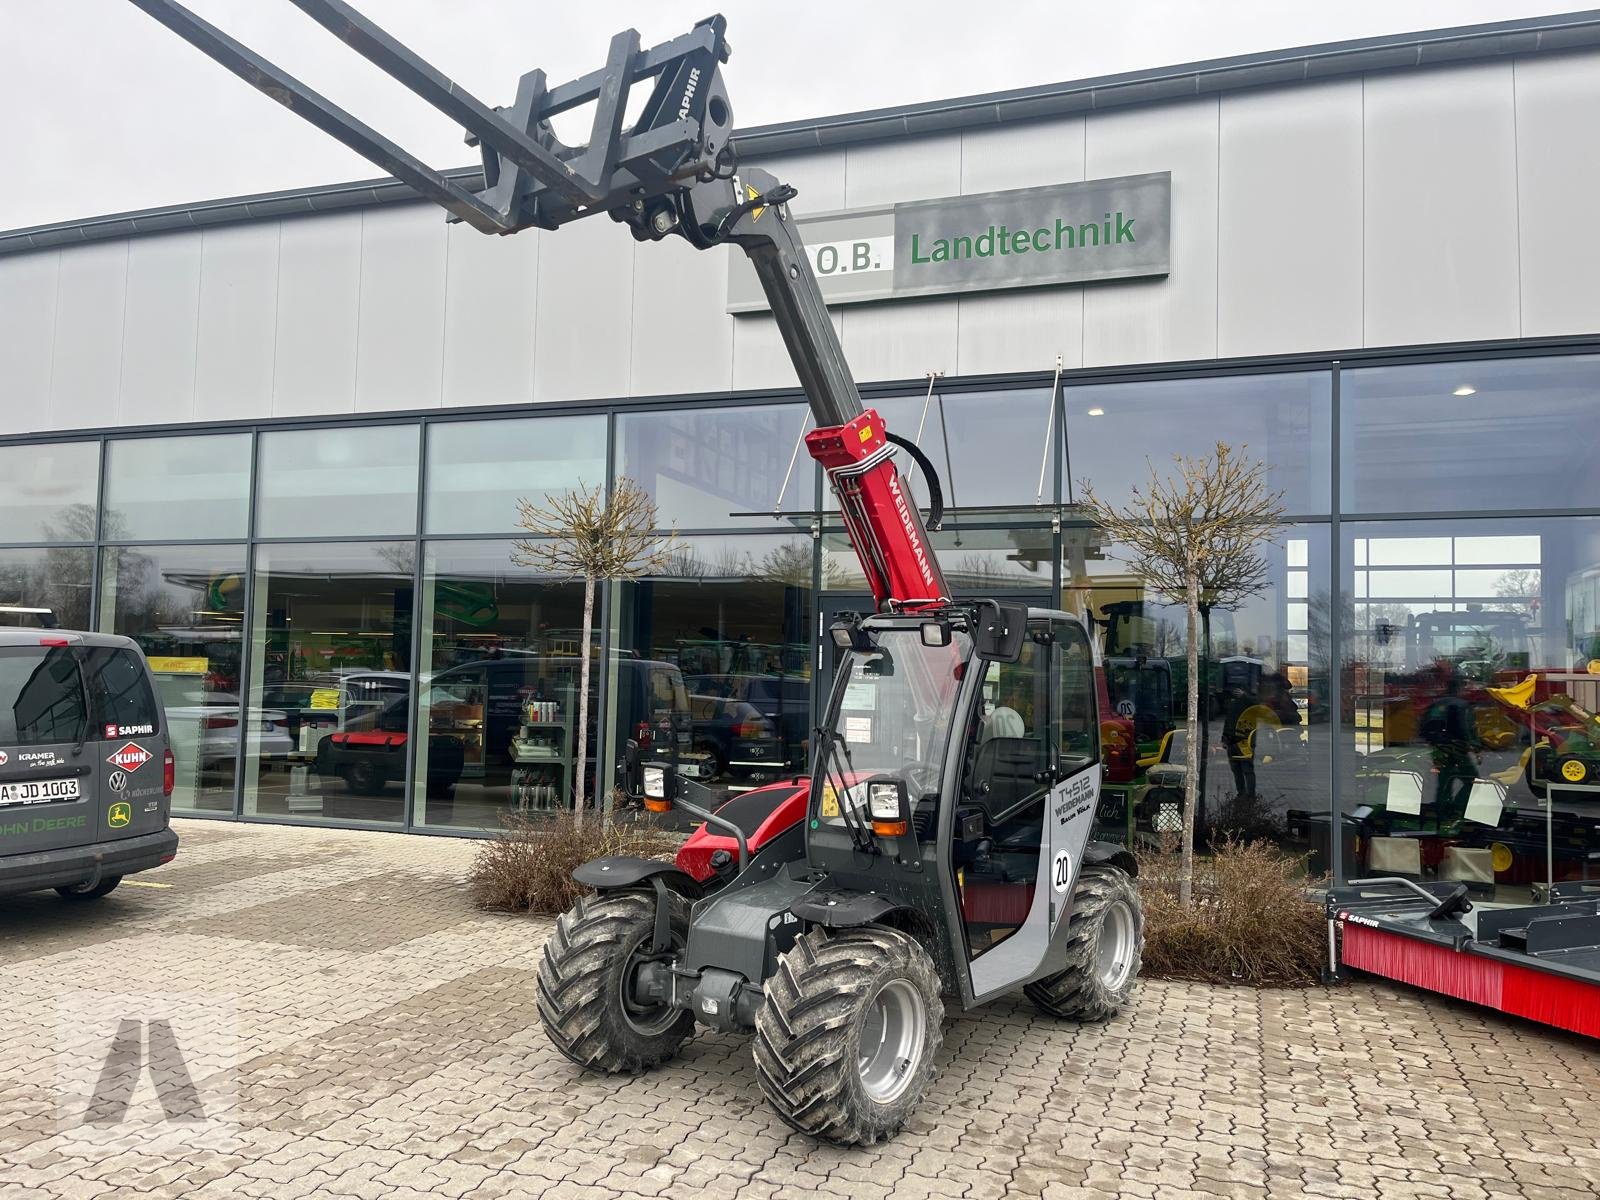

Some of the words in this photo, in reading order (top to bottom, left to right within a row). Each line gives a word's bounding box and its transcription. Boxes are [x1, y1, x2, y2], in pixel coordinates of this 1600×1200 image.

[676, 67, 701, 121] APHIR
[911, 211, 1136, 265] Landtechnik
[889, 474, 934, 587] WEIDEMANN
[119, 724, 153, 735] SAPHIR
[18, 752, 55, 761] KRAMER
[115, 752, 146, 765] KUHN
[20, 783, 39, 799] JD
[42, 781, 77, 798] 1003
[1059, 775, 1091, 802] T4512
[1055, 788, 1094, 817] WEIDEMANN
[1056, 856, 1068, 886] 20
[1347, 914, 1380, 928] SAPHIR
